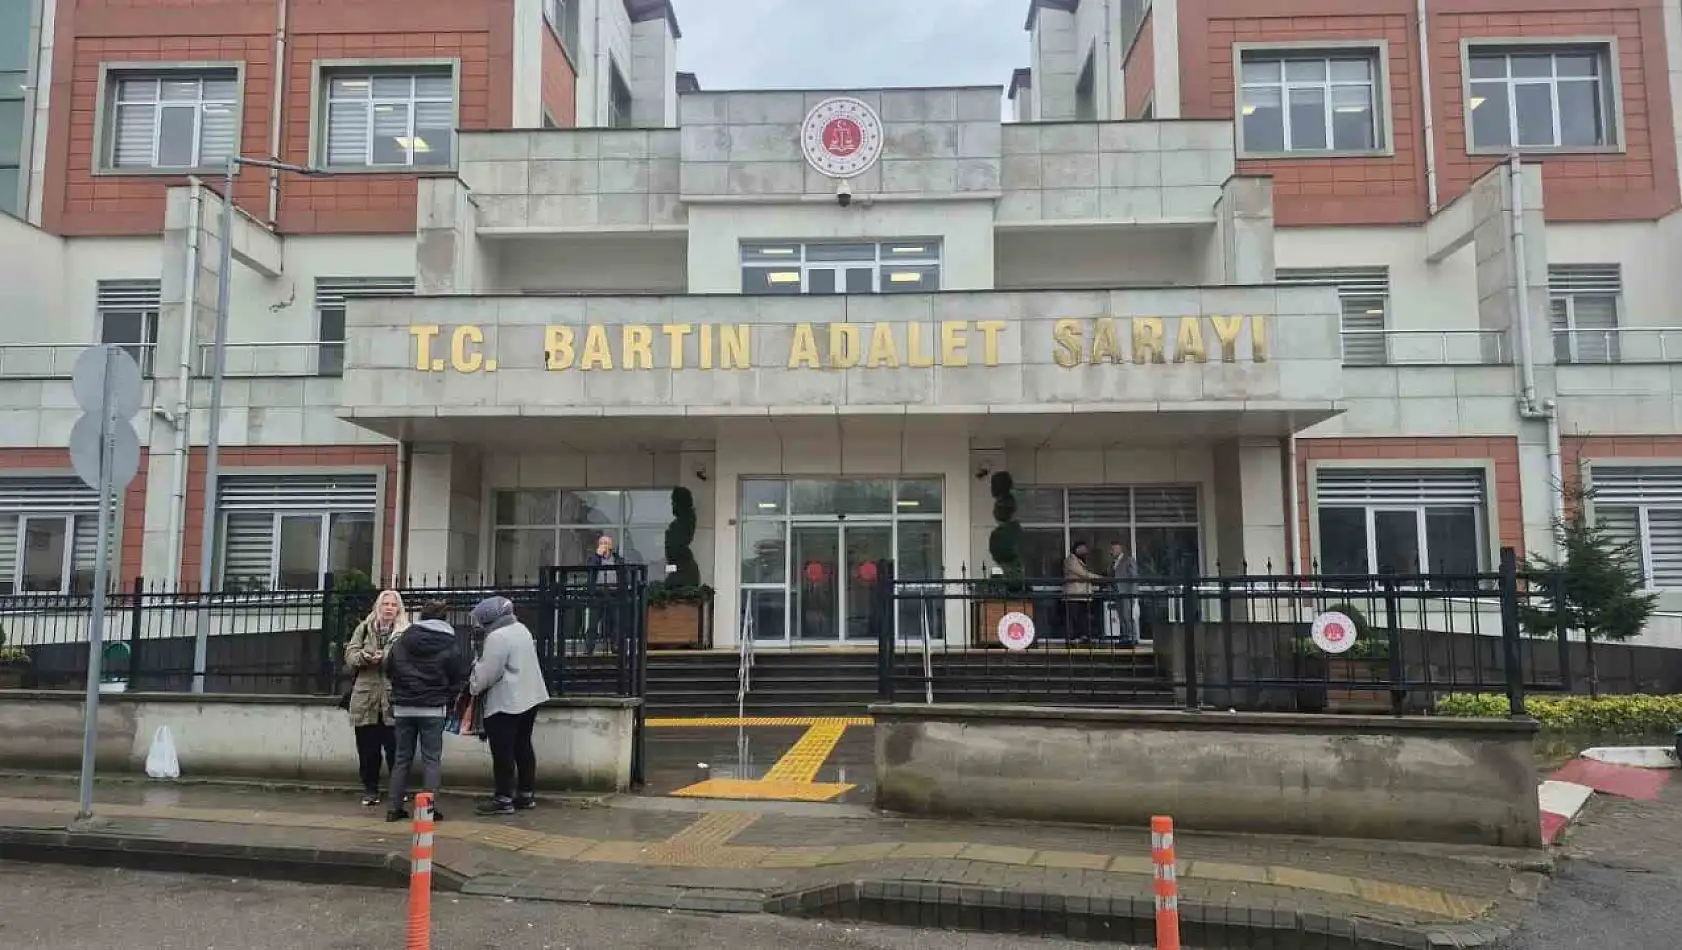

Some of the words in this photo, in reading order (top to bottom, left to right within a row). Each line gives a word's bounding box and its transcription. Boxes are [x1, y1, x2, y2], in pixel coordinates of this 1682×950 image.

[410, 324, 499, 373] T.C.
[544, 322, 751, 371] BARTIN
[788, 320, 1006, 369] ADALET
[1052, 314, 1268, 368] SARAYI
